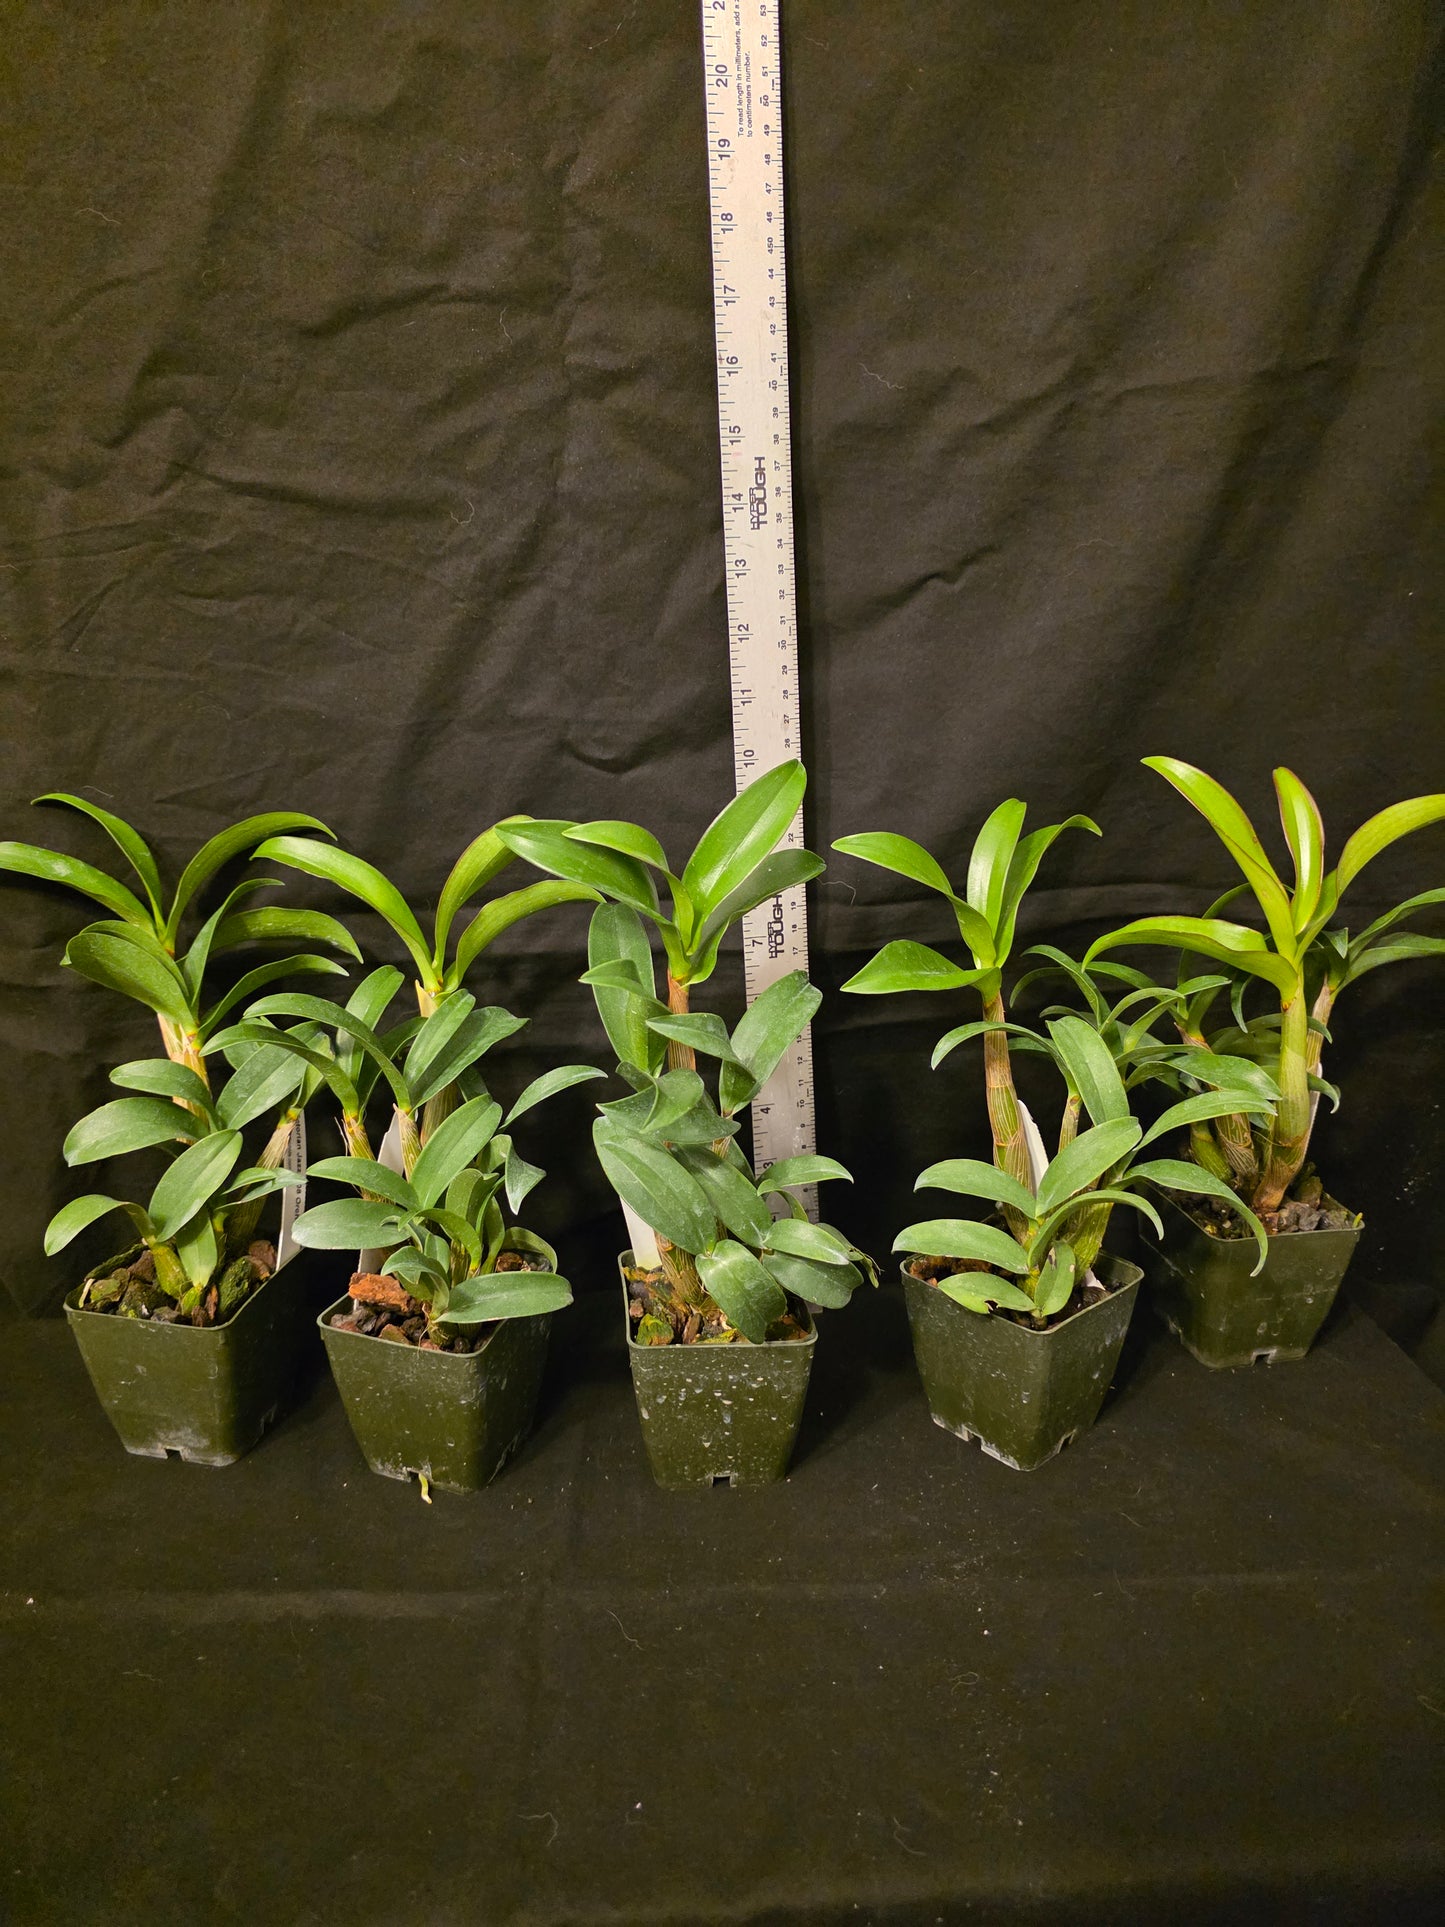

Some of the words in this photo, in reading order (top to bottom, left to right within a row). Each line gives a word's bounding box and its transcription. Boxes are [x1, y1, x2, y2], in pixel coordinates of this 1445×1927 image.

[760, 4, 767, 17] 53
[761, 34, 768, 47] 52
[744, 51, 752, 83] number.
[762, 65, 768, 77] 51
[715, 64, 728, 88] 20
[736, 73, 742, 81] in
[736, 82, 744, 108] length
[763, 94, 769, 107] 50
[745, 84, 753, 128] centimeters
[737, 127, 744, 138] To
[747, 129, 753, 138] to
[764, 124, 770, 136] 49
[718, 138, 731, 160] 19
[765, 153, 771, 166] 48
[765, 182, 772, 195] 47
[720, 212, 734, 234] 18
[766, 211, 773, 224] 46
[768, 268, 774, 280] 44
[723, 284, 737, 307] 17
[769, 296, 776, 308] 43
[770, 323, 776, 335] 42
[771, 352, 777, 363] 41
[726, 355, 739, 377] 16
[771, 379, 778, 391] 40
[772, 406, 779, 419] 39
[729, 425, 742, 446] 15
[773, 433, 779, 445] 38
[774, 460, 780, 471] 37
[754, 456, 768, 525] TOUGH
[775, 486, 781, 498] 36
[731, 492, 744, 513] 14
[749, 487, 760, 531] HYPER
[776, 512, 783, 524] 35
[777, 538, 783, 550] 34
[734, 558, 747, 579] 13
[778, 564, 784, 575] 33
[779, 589, 785, 600] 32
[780, 615, 786, 625] 31
[737, 623, 750, 643] 12
[781, 639, 787, 650] 30
[782, 664, 788, 675] 29
[740, 689, 752, 706] 11
[783, 689, 789, 700] 28
[784, 714, 790, 724] 27
[785, 738, 791, 749] 26
[743, 749, 755, 768] 10
[788, 832, 794, 843] 22
[790, 901, 797, 910] 19
[772, 894, 785, 954] TOUGH
[791, 924, 798, 933] 18
[752, 939, 763, 948] 7
[767, 921, 778, 959] HYPER
[792, 946, 799, 955] 17
[797, 1056, 803, 1065] 12
[798, 1079, 804, 1087] 11
[799, 1099, 805, 1108] 10
[760, 1106, 771, 1115] 4
